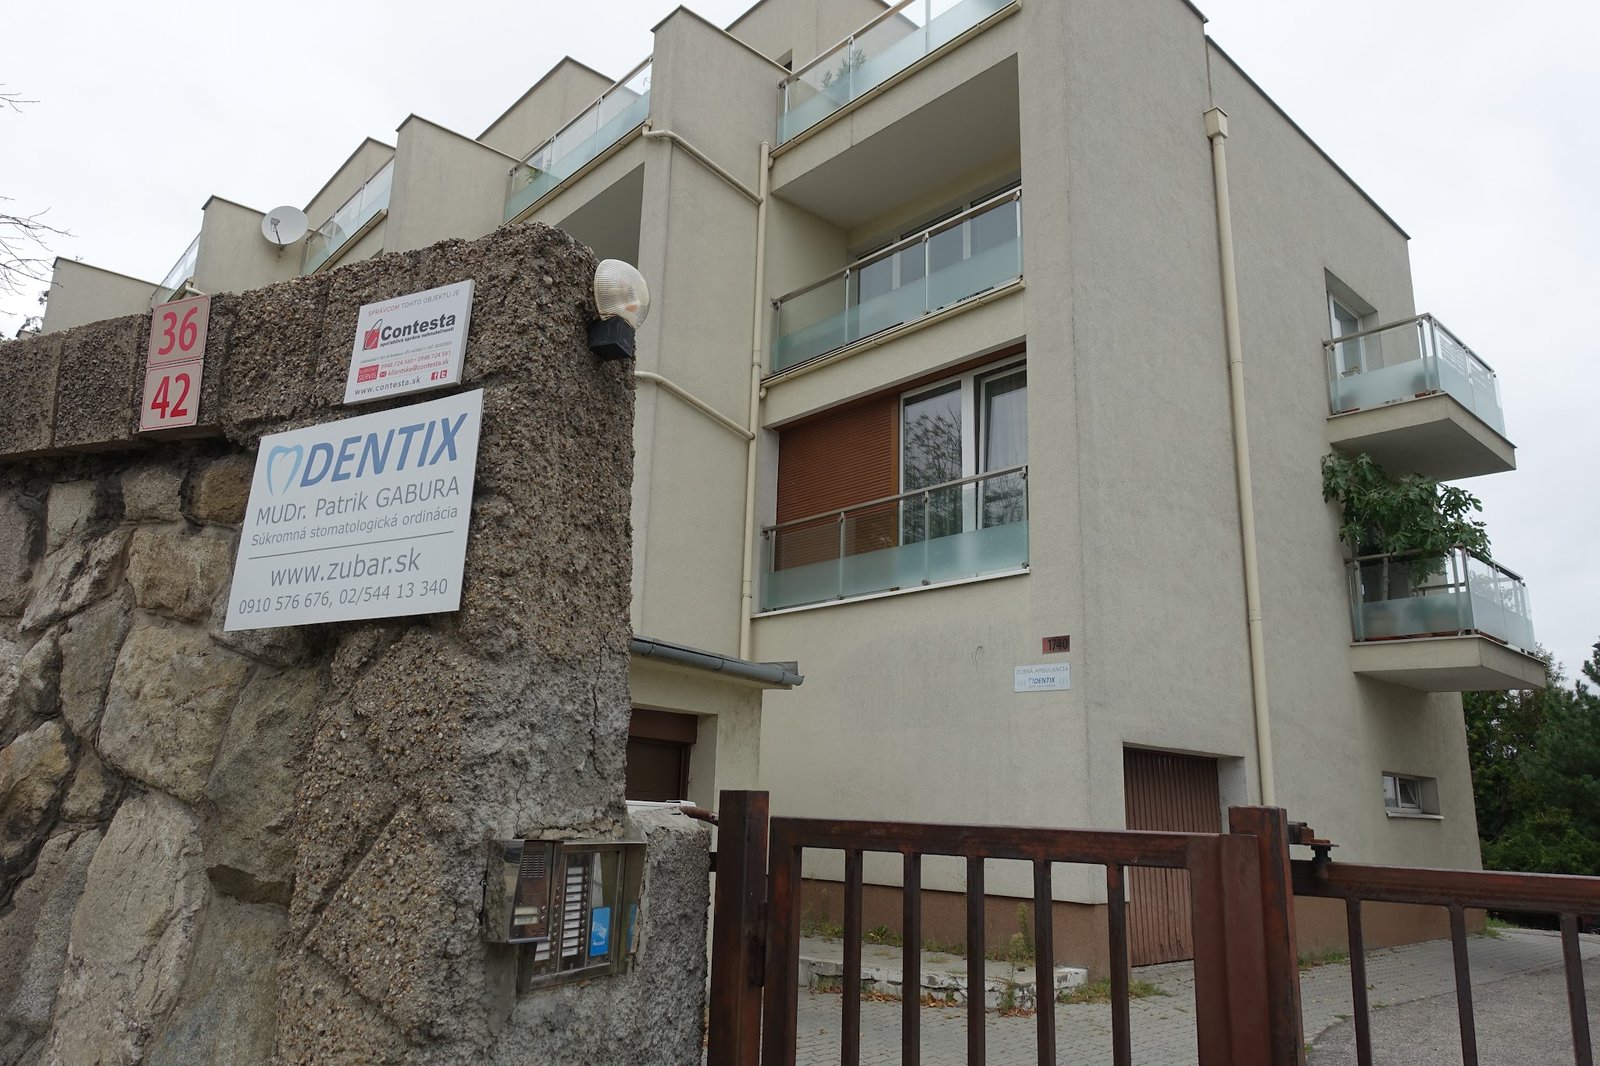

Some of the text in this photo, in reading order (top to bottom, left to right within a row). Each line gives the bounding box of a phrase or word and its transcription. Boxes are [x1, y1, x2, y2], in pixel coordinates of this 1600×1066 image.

[401, 299, 422, 309] TOHTO
[158, 306, 198, 356] 36
[381, 313, 456, 341] Contesta
[150, 373, 191, 419] 42
[354, 375, 421, 396] www.contesta.sk
[300, 413, 468, 488] DENTIX
[255, 475, 460, 526] MUDr. Patrik GABURA
[251, 505, 458, 546] Súkromná stomatologická ordinácia
[270, 547, 422, 587] www.zubar.sk
[238, 578, 448, 615] 0910 576 676, 02/544 13 340
[1048, 638, 1067, 651] 1740
